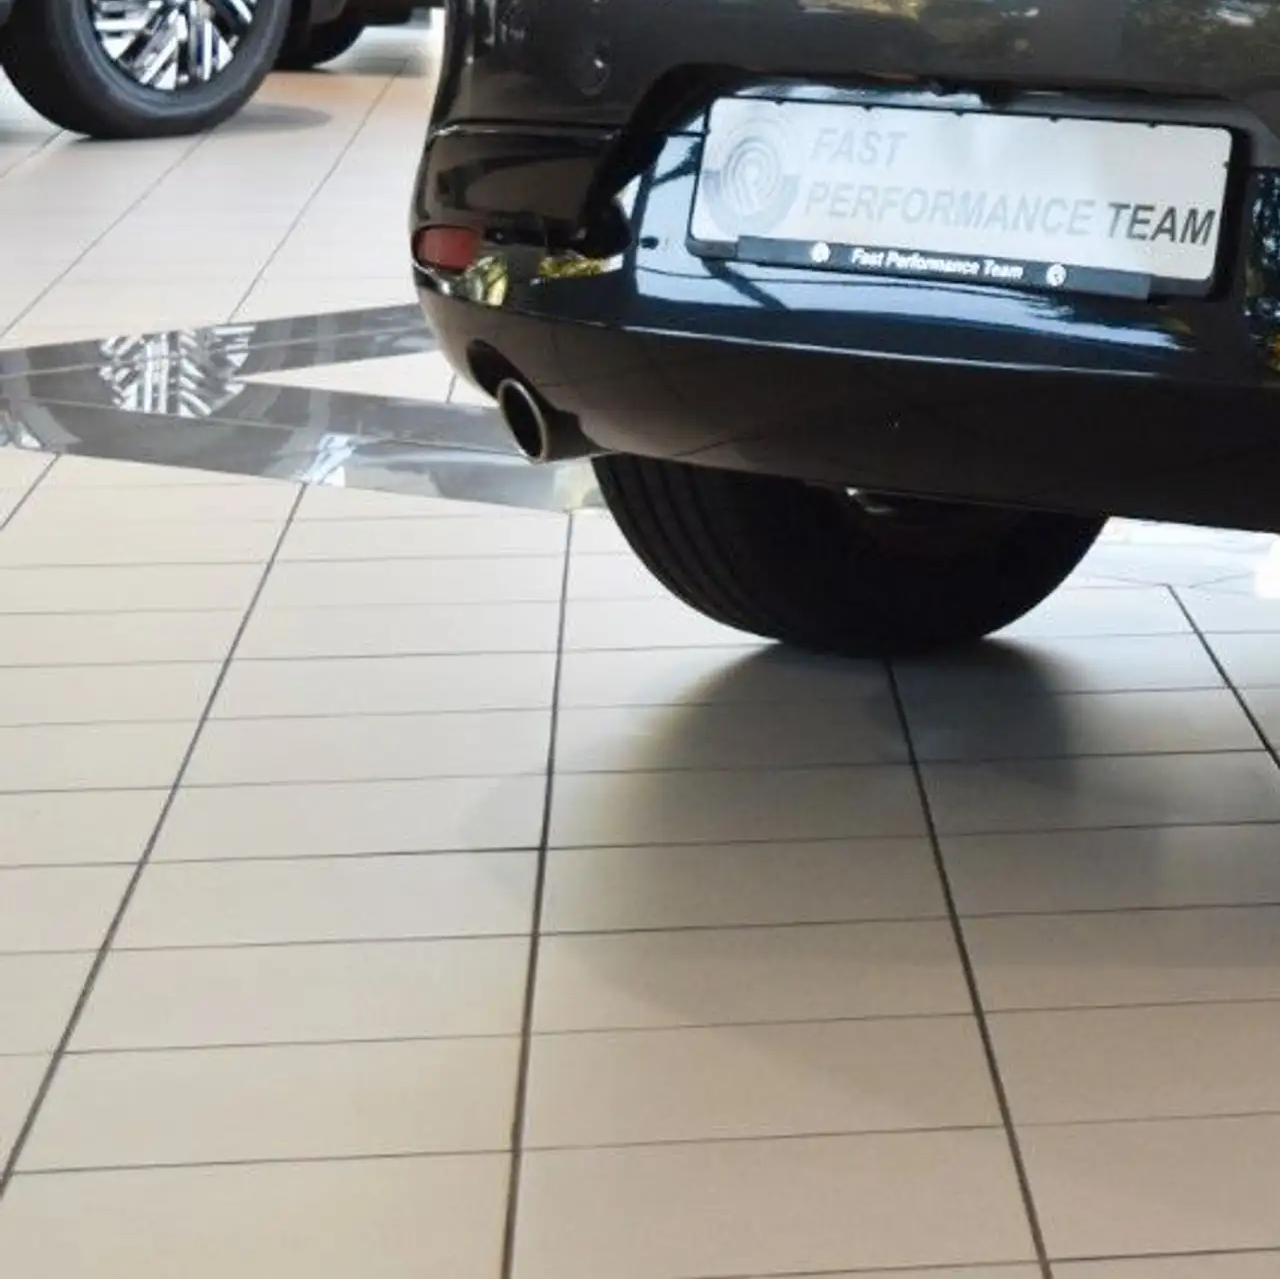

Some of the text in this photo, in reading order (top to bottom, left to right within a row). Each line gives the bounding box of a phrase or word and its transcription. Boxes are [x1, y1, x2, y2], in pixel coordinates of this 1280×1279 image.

[810, 126, 908, 167] FAST
[804, 180, 1218, 247] PERFORMANCE TEAM
[852, 246, 1024, 279] Fast Performance Team
